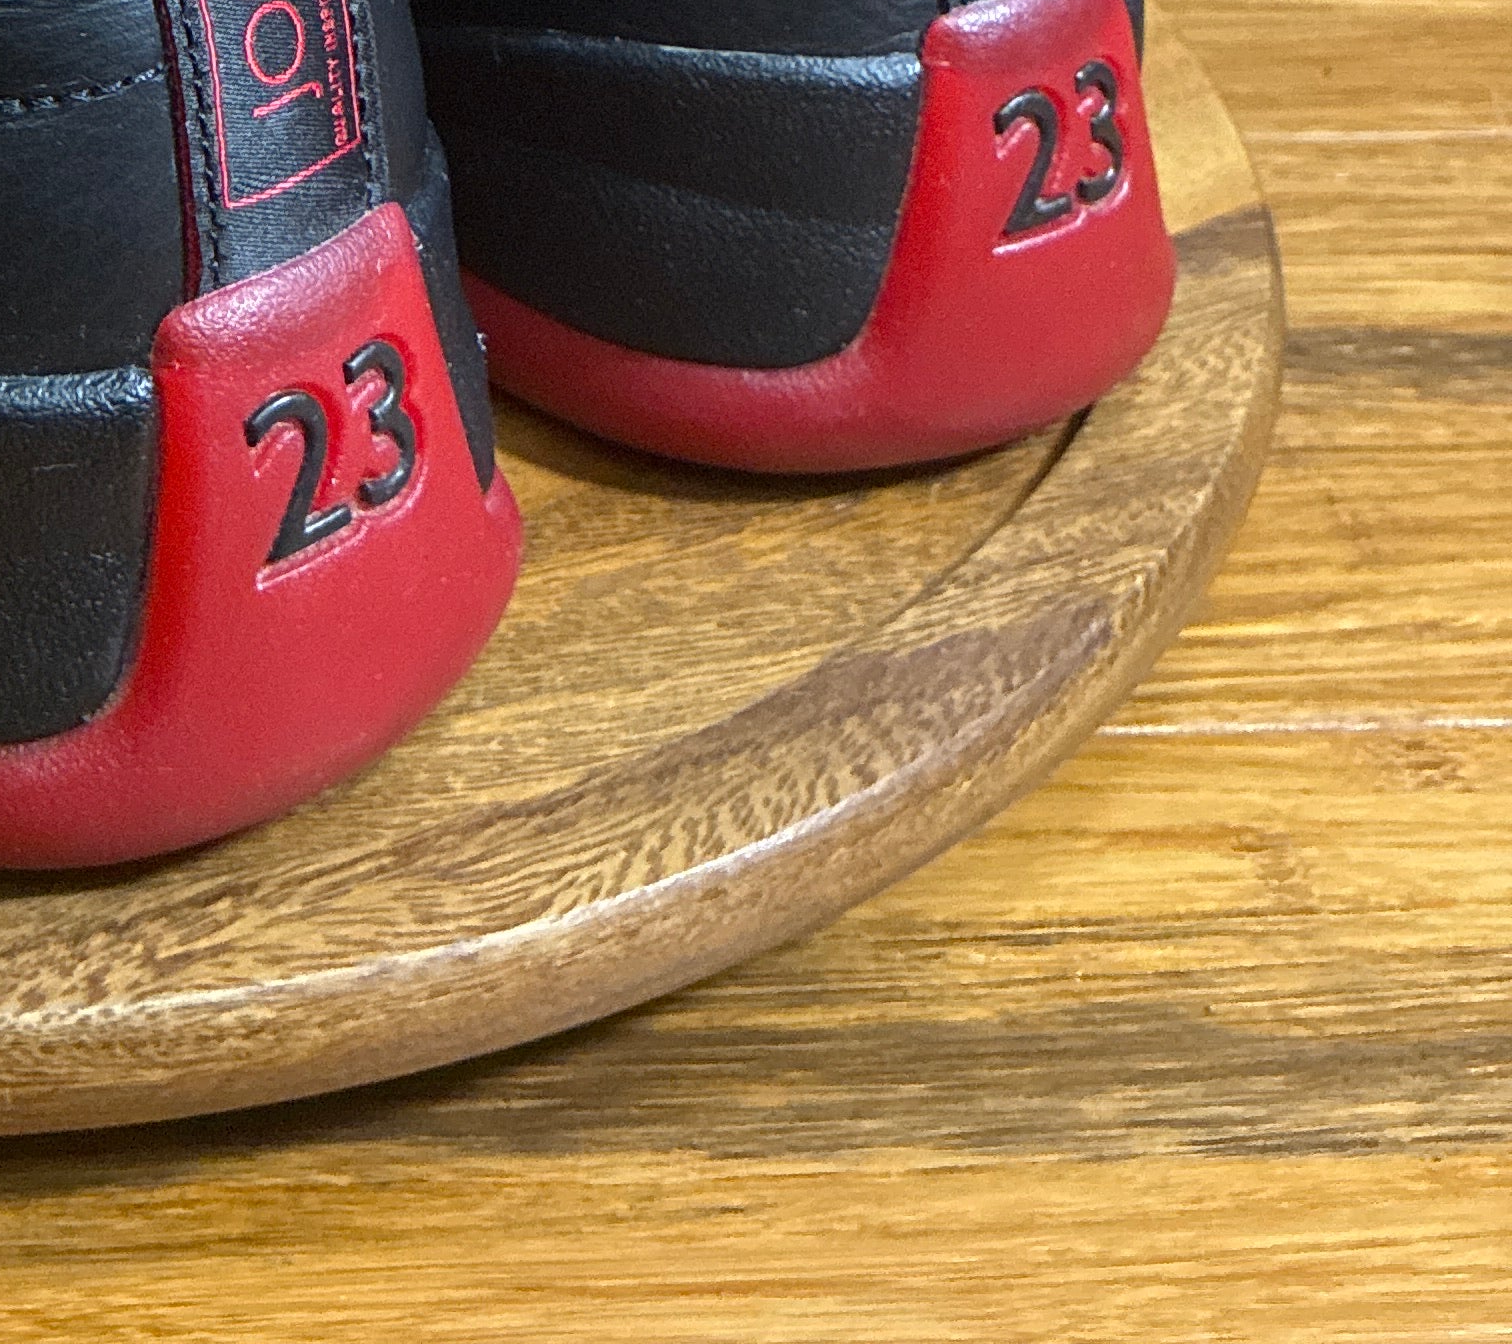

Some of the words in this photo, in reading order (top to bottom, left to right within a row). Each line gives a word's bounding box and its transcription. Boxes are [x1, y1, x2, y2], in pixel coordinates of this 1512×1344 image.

[325, 57, 349, 147] QUALITY
[992, 59, 1124, 238] 23
[242, 338, 418, 567] 23
